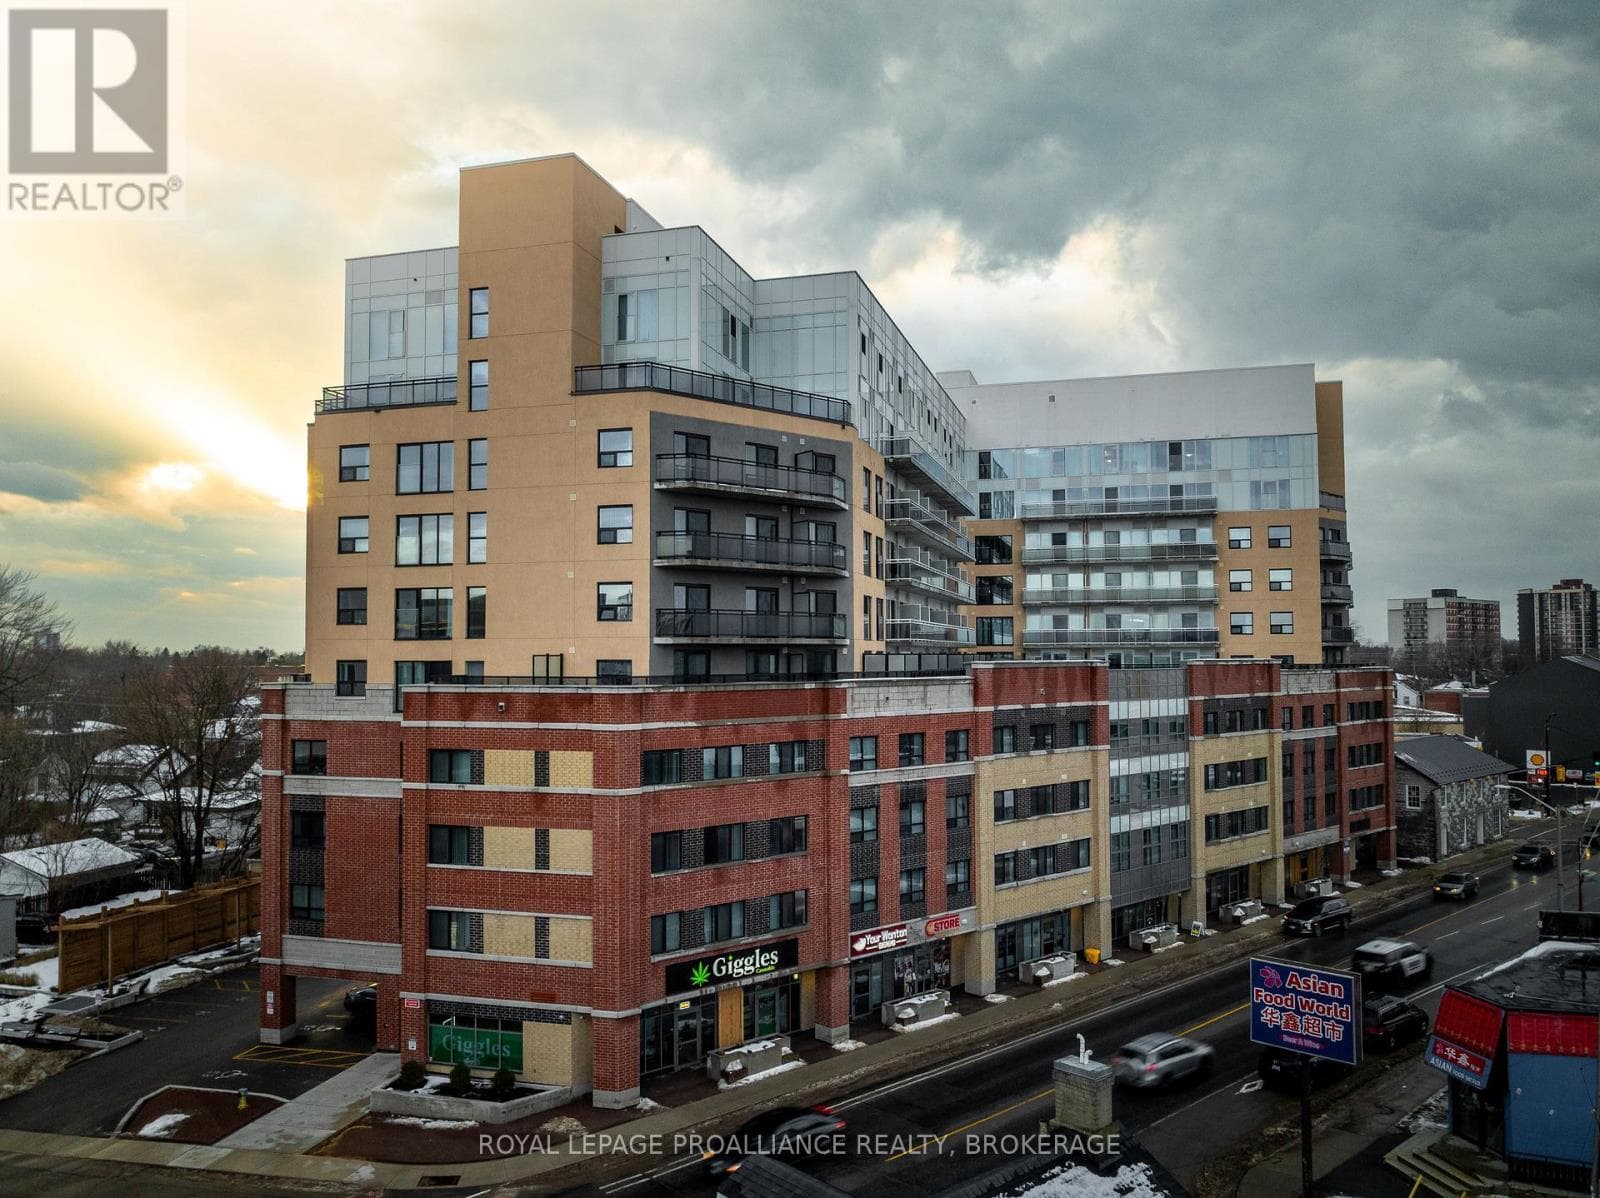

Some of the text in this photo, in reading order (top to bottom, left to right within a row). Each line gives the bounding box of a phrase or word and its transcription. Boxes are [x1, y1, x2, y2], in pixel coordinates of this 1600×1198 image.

[934, 917, 960, 932] STORE
[712, 948, 779, 978] Giggles
[1285, 971, 1345, 999] Asian
[1254, 987, 1352, 1022] Food World
[1260, 1007, 1345, 1043] 华鑫超市
[442, 1033, 512, 1058] Giggles
[1429, 1057, 1452, 1073] ASIAN
